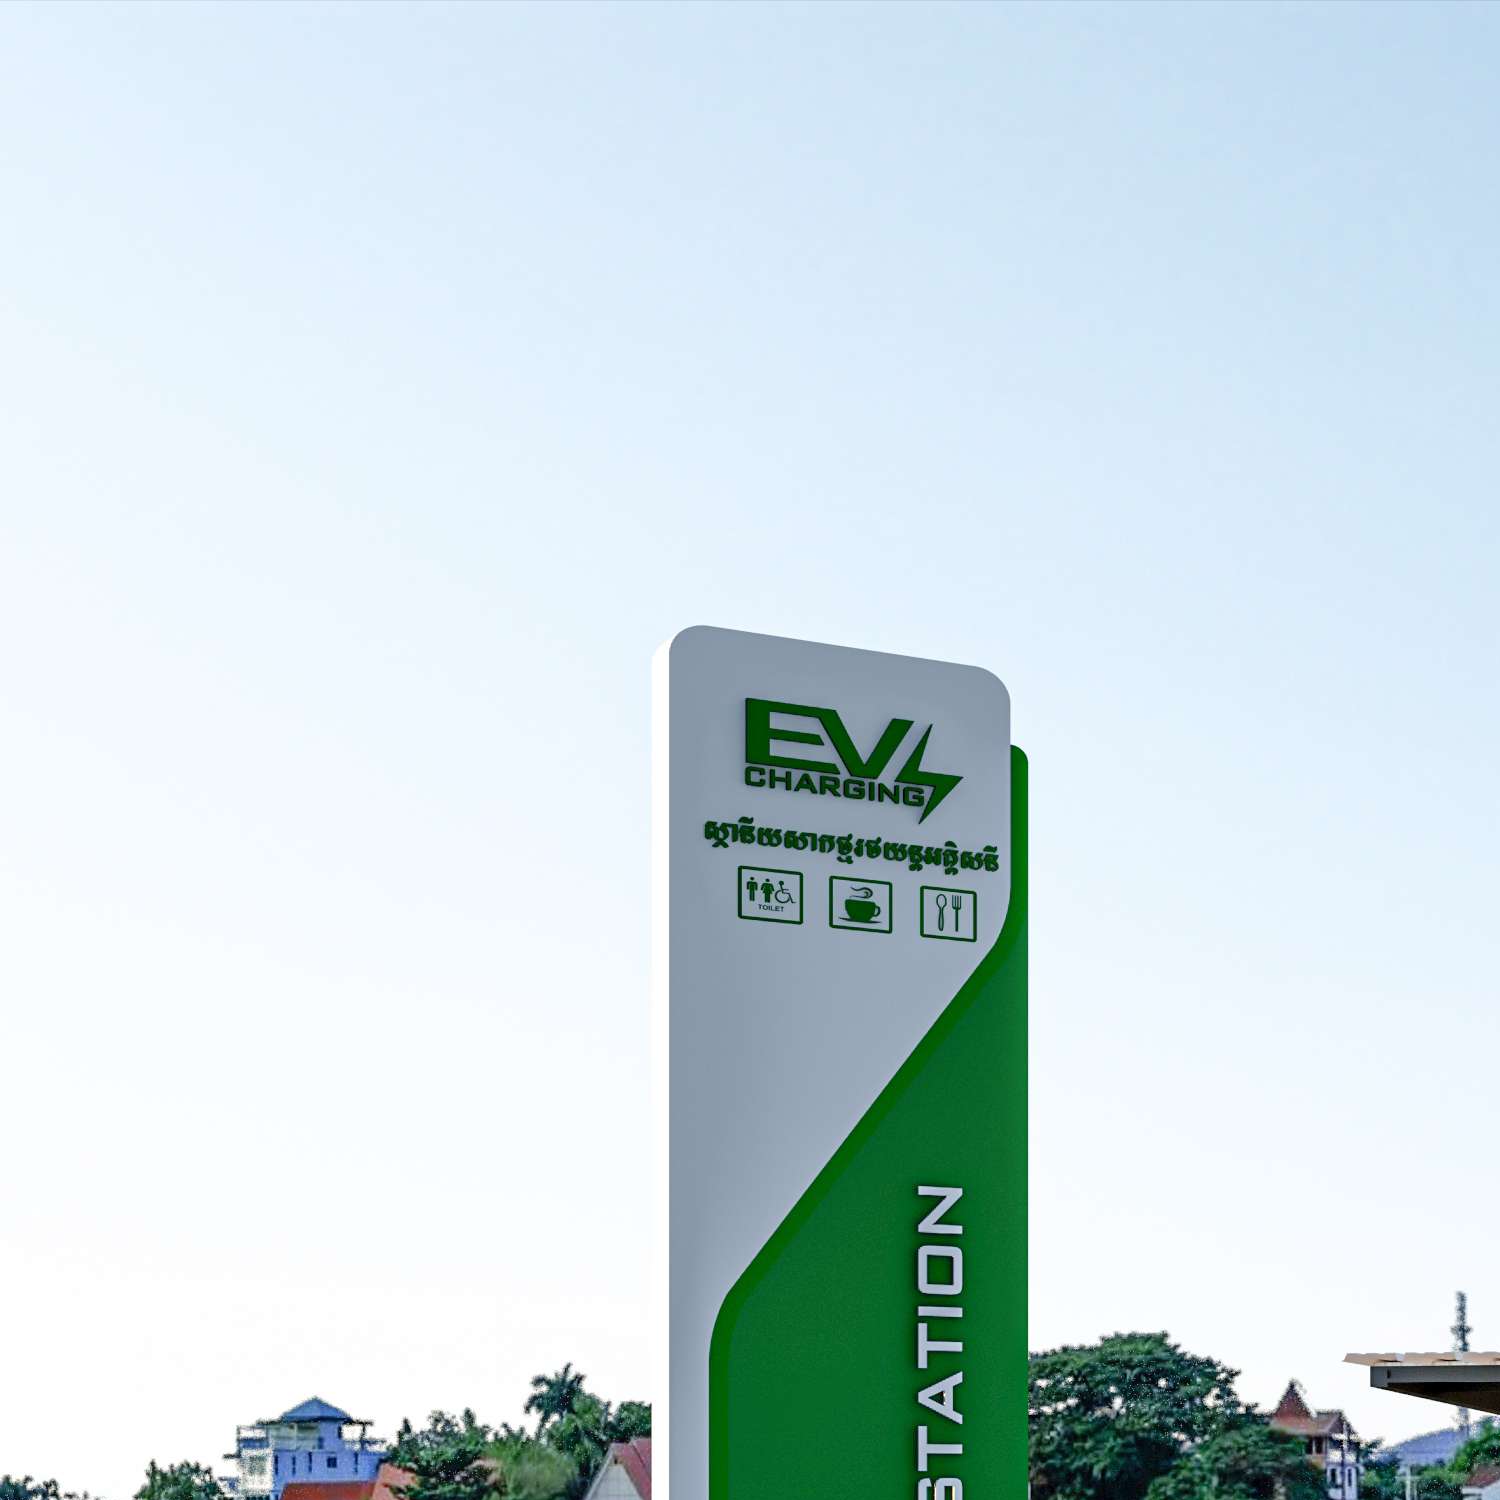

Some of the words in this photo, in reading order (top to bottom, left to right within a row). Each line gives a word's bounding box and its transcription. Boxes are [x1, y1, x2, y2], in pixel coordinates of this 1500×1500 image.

[745, 698, 915, 779] EV
[744, 765, 925, 807] CHARGING
[758, 904, 785, 912] TOILET
